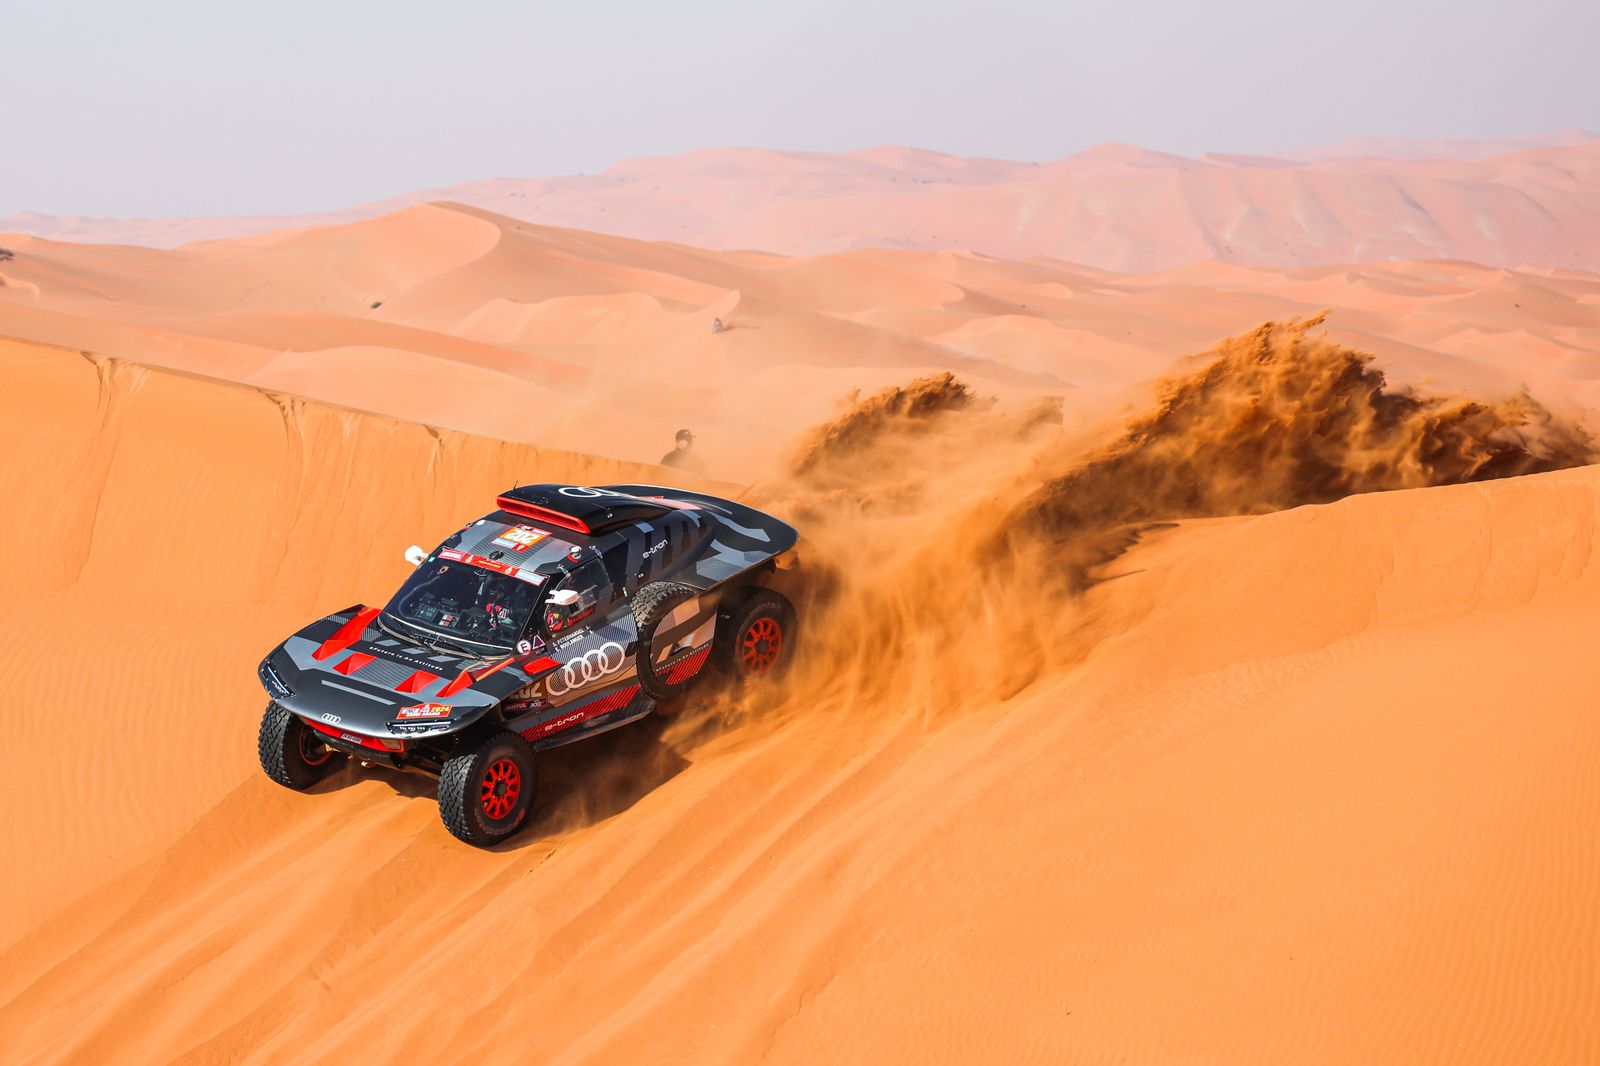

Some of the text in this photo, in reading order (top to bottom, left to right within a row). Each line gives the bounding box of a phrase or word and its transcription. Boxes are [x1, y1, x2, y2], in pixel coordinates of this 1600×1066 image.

[642, 539, 668, 558] e-tron
[414, 659, 443, 671] Attitude
[544, 712, 584, 731] e-tron
